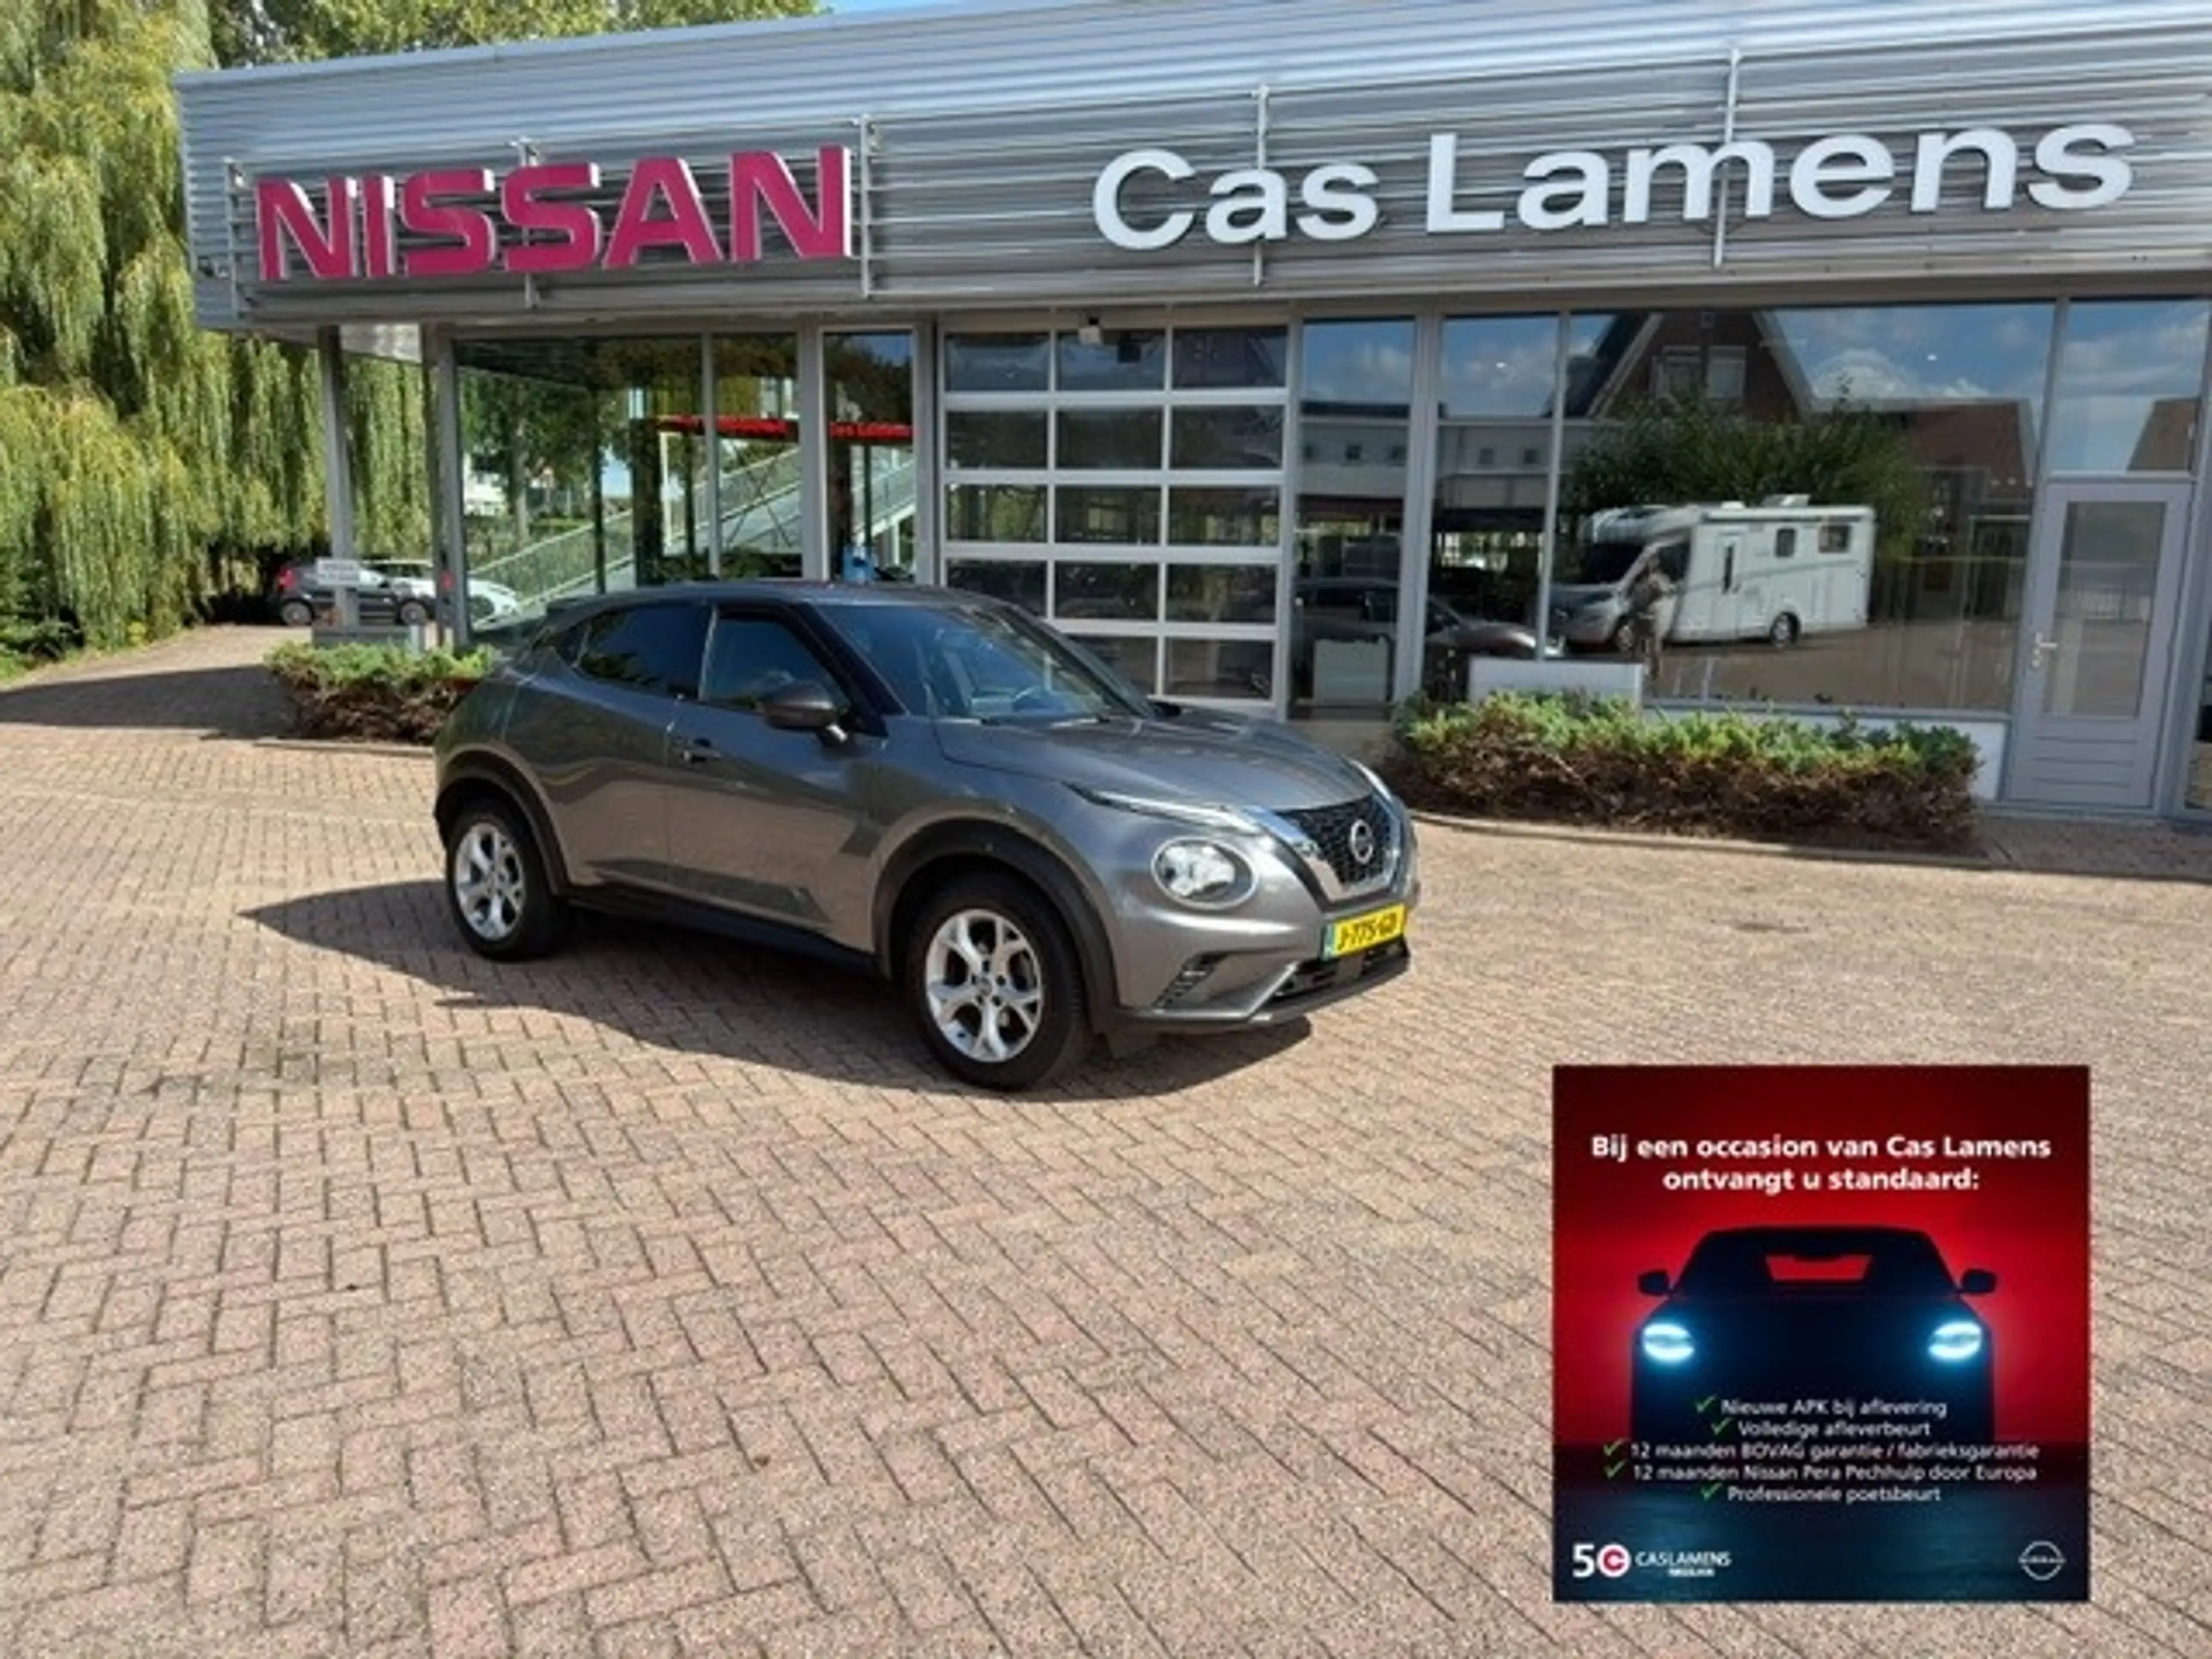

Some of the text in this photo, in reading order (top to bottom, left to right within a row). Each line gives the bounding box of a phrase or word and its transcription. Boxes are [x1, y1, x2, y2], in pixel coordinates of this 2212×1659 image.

[255, 144, 854, 281] NISSAN
[1092, 122, 2137, 251] Cas Lamens
